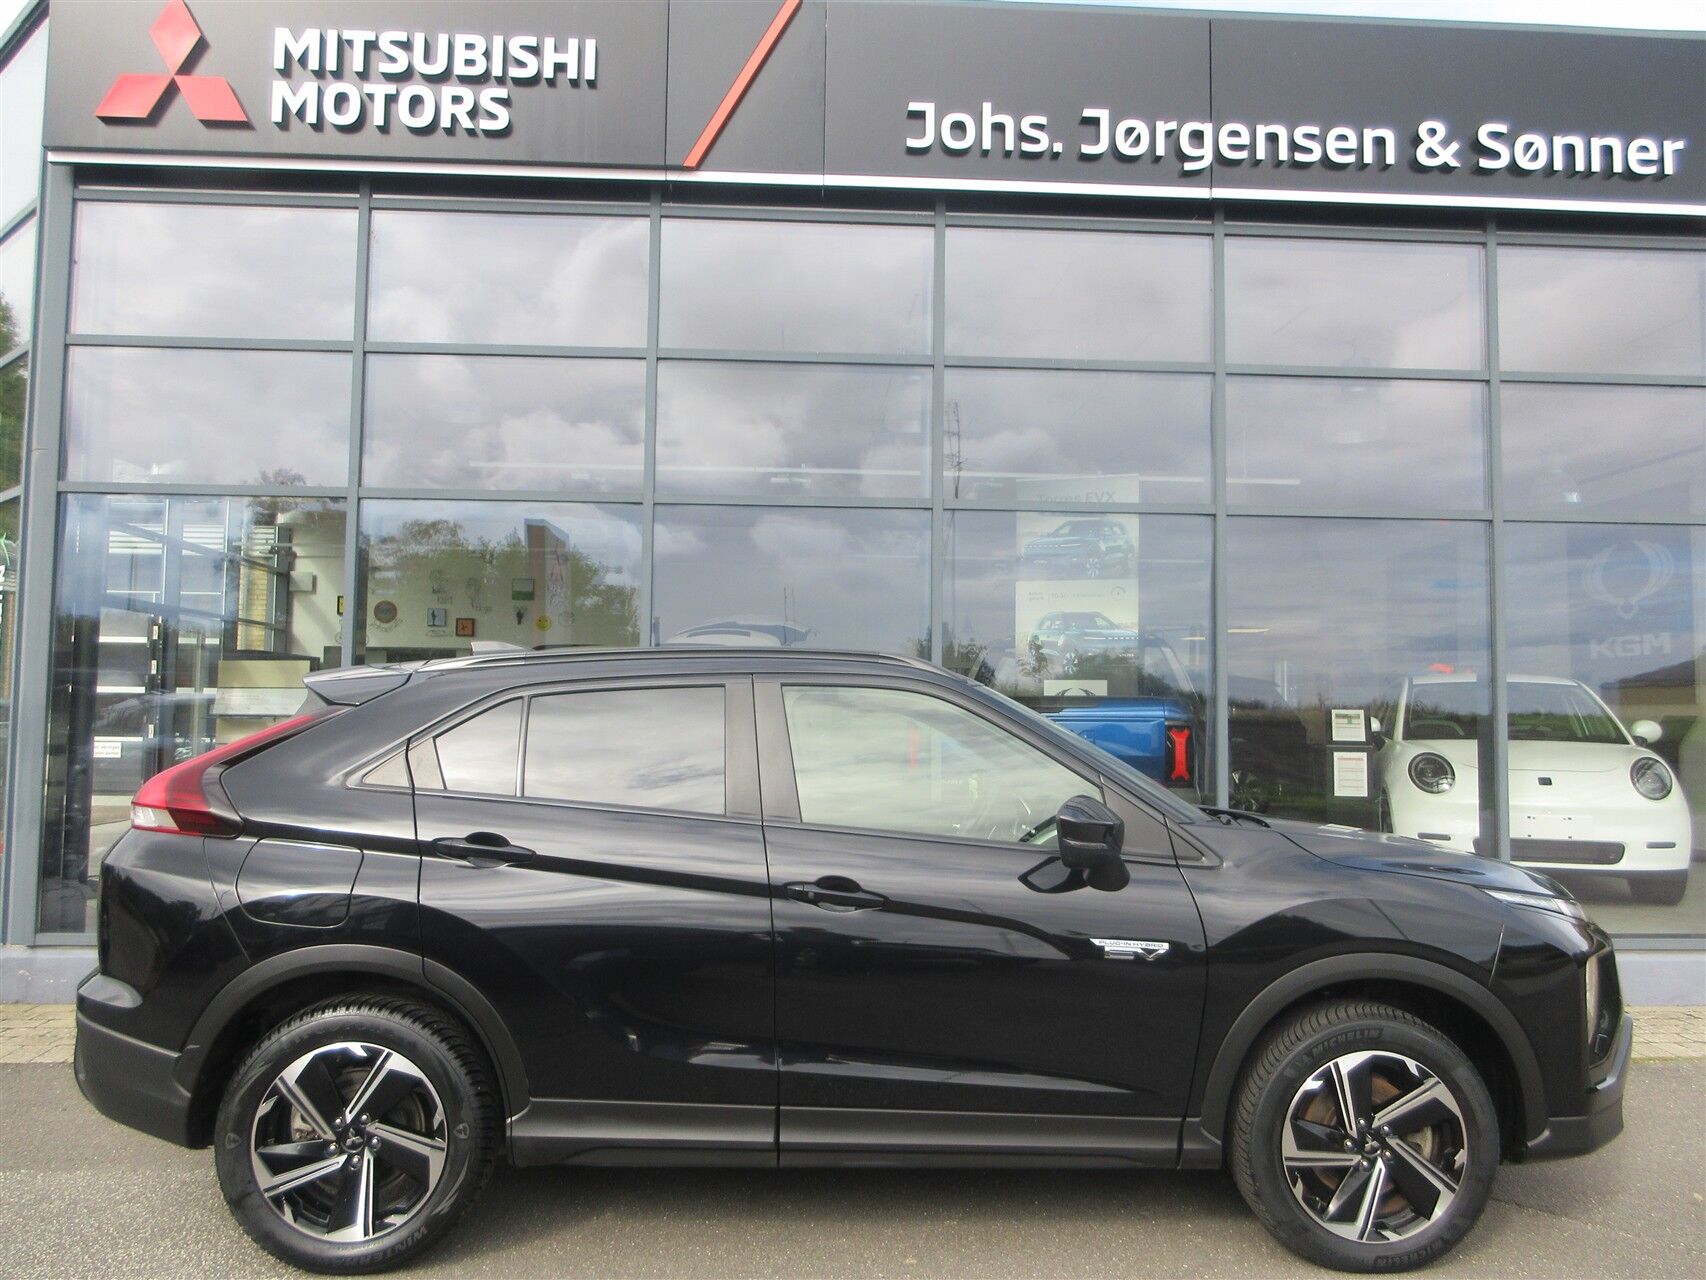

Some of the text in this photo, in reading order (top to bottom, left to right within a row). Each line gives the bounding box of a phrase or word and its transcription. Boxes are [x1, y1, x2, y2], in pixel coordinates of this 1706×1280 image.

[272, 27, 597, 80] MITSUBISHI
[271, 80, 511, 130] MOTORS
[905, 101, 1685, 176] Johs. Jørgensen & Sønner
[1590, 632, 1672, 660] KGM
[1312, 1027, 1382, 1058] MICHELIN
